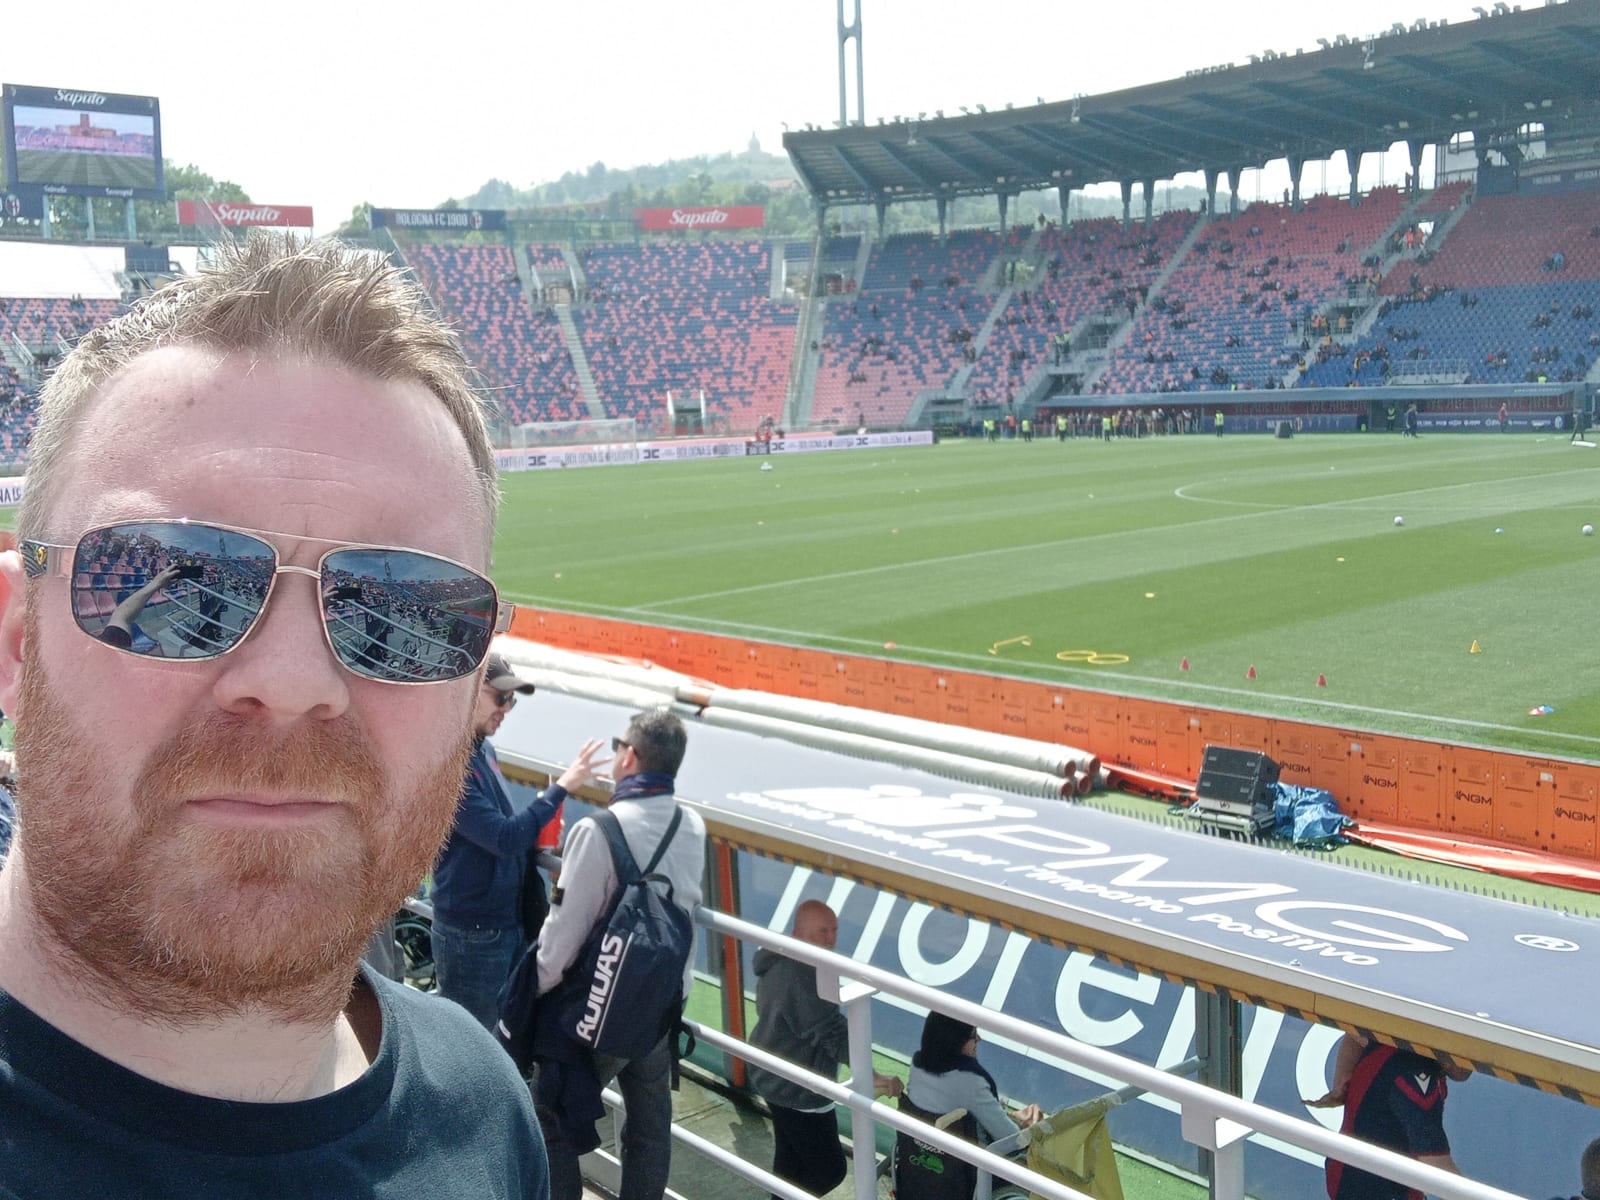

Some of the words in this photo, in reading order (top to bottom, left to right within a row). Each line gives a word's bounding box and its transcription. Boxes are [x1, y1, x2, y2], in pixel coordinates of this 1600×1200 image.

[54, 90, 106, 106] Saputo
[218, 204, 281, 225] Saputo
[395, 212, 433, 226] BOLOGNA
[434, 213, 446, 226] FC
[668, 209, 728, 228] Saputo
[1280, 760, 1311, 774] NGM
[1363, 774, 1398, 789] NGM
[1456, 790, 1492, 806] NGM
[1555, 806, 1596, 824] NGM
[922, 825, 1470, 952] PMG
